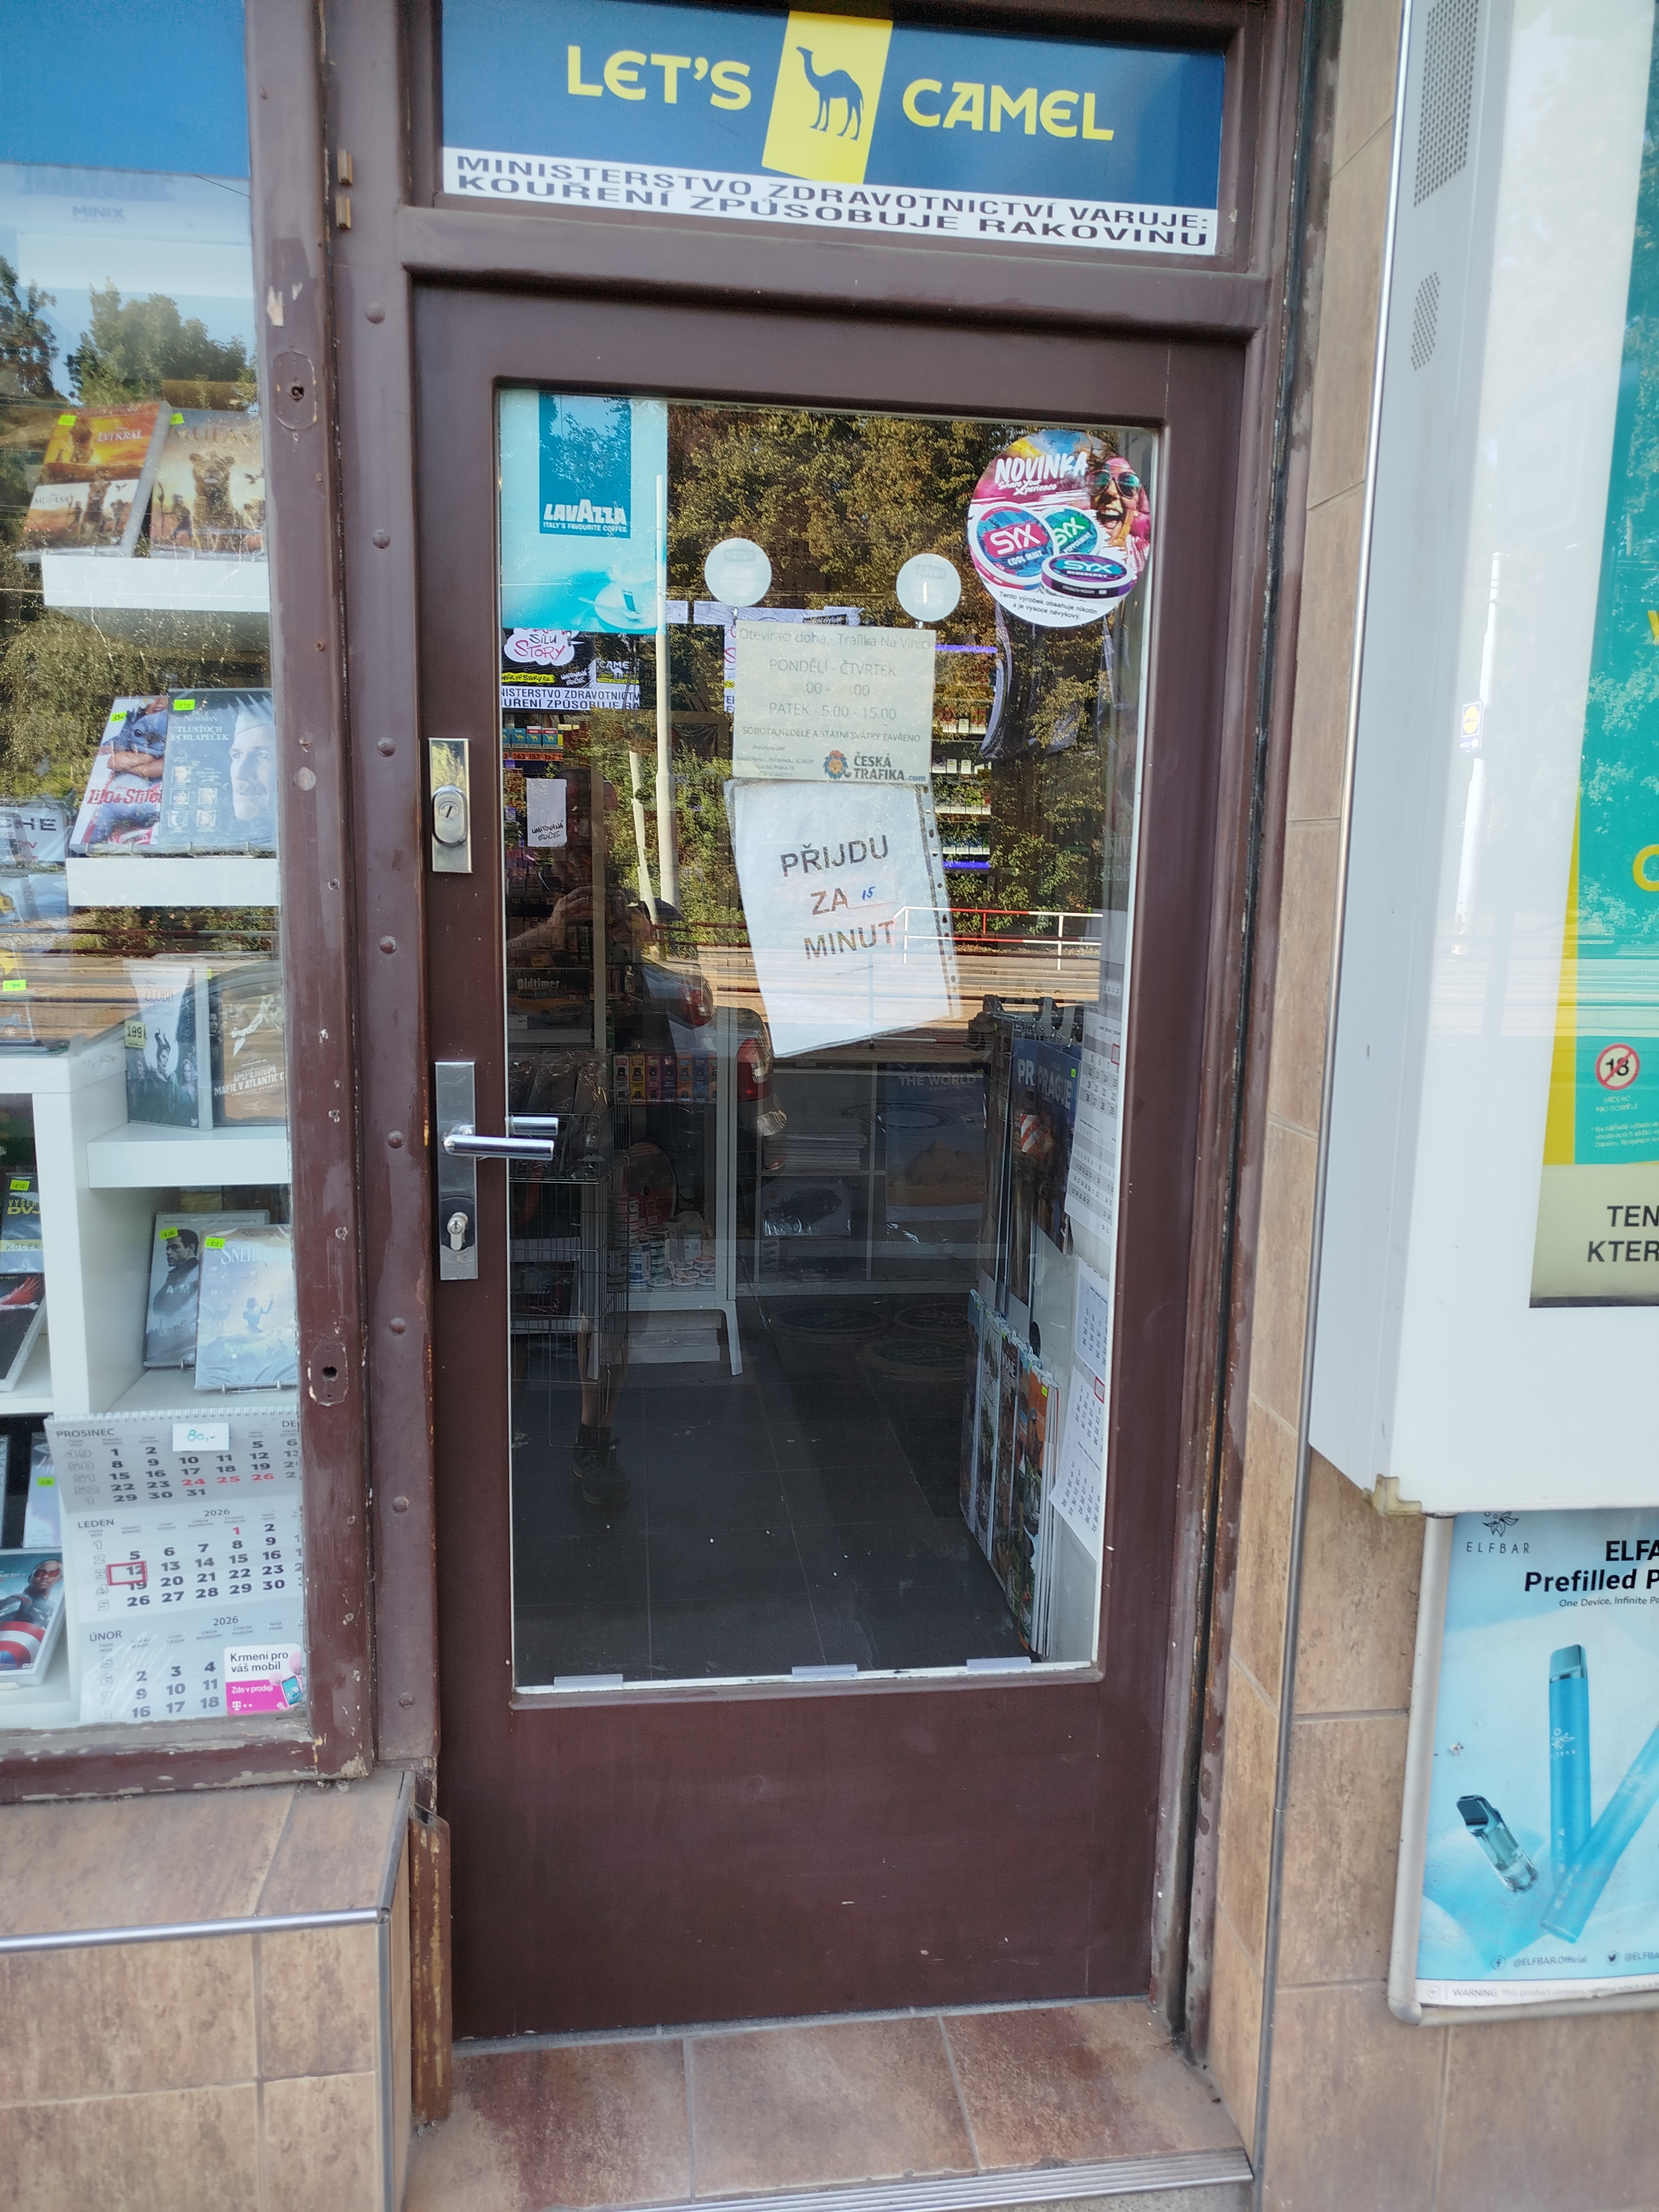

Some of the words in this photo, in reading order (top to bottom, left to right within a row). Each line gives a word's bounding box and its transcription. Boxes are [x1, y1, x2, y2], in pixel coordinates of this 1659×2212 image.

[567, 44, 752, 111] LET'S
[902, 78, 1114, 141] CAMEL
[457, 155, 752, 196] MINISTERSTVO
[768, 183, 1054, 219] ZDRAVOTNICTVÍ
[1069, 206, 1208, 231] VARUJE:
[72, 205, 125, 219] MINIX
[458, 175, 670, 207] KOUŘENÍ
[690, 195, 959, 231] ZPŮSOBUJE
[979, 218, 1207, 247] RAKOVINU
[994, 451, 1088, 484] NOVINKA
[998, 479, 1022, 490] Share
[33, 496, 69, 504] MUFASA
[543, 498, 627, 525] LAVAZZA
[567, 523, 601, 531] FAVOURITE
[990, 524, 1041, 555] SYX
[1007, 555, 1026, 566] COOL
[1063, 559, 1113, 573] SYX
[999, 591, 1017, 600] Tento
[1019, 596, 1044, 606] výrobek
[1045, 601, 1074, 611] obsahuje
[795, 632, 826, 644] doba
[837, 633, 877, 646] Trafika
[881, 637, 896, 648] Na
[769, 658, 829, 674] PONDĚLÍ
[840, 659, 896, 677] ČTVRTEK
[769, 700, 810, 716] PÁTEK
[863, 707, 896, 720] 15.00
[820, 729, 848, 739] STÁTNÍ
[851, 731, 880, 740] SVÁTKY
[883, 732, 921, 743] ZAVŘENO
[853, 751, 892, 768] ČESKÁ
[538, 830, 561, 841] EDICE
[780, 834, 889, 878] PŘIJDU
[810, 887, 849, 916] ZA
[861, 886, 876, 901] 15
[804, 920, 894, 960] MINUT
[127, 1025, 142, 1039] 199
[234, 1063, 276, 1082] IMPÉRIUM
[214, 1082, 237, 1096] MAFIE
[245, 1073, 279, 1089] ATLANTIC
[899, 1076, 925, 1086] THE
[927, 1076, 976, 1086] WORLD
[1037, 1065, 1073, 1110] PRAGUE
[56, 1428, 114, 1438] PROSINEC
[204, 1508, 230, 1517] 2026
[77, 1519, 114, 1529] LEDEN
[233, 1526, 241, 1535] 1
[264, 1523, 275, 1532] 2
[129, 1551, 141, 1560] 5
[164, 1547, 175, 1556] 6
[197, 1543, 209, 1553] 7
[232, 1540, 243, 1549] 8
[265, 1536, 276, 1546] 9
[1466, 1541, 1531, 1554] ELFBAR
[228, 1553, 248, 1564] 15
[262, 1550, 281, 1560] 16
[1524, 1568, 1637, 1593] Prefilled
[1559, 1598, 1578, 1608] One
[1580, 1597, 1612, 1606] Device.
[1614, 1595, 1647, 1605] Infinite
[213, 1615, 239, 1626] 2026
[90, 1630, 122, 1642] ÚNOR
[230, 1650, 269, 1662] Krmení
[271, 1652, 289, 1661] pro
[136, 1670, 147, 1682] 2
[171, 1665, 181, 1677] 3
[204, 1661, 216, 1672] 4
[231, 1663, 249, 1673] váš
[251, 1661, 281, 1671] mobil
[136, 1688, 147, 1700] 9
[166, 1683, 186, 1695] 10
[202, 1678, 218, 1690] 11
[251, 1684, 273, 1694] prodeji
[132, 1705, 151, 1718] 16
[166, 1700, 186, 1713] 17
[200, 1696, 220, 1709] 18
[1512, 1955, 1588, 1968] @ELFBAR.Official
[1453, 1988, 1499, 1997] WARNING:
[1502, 1987, 1518, 1996] This
[1519, 1987, 1551, 1998] product
[1552, 1986, 1586, 1996] contains
